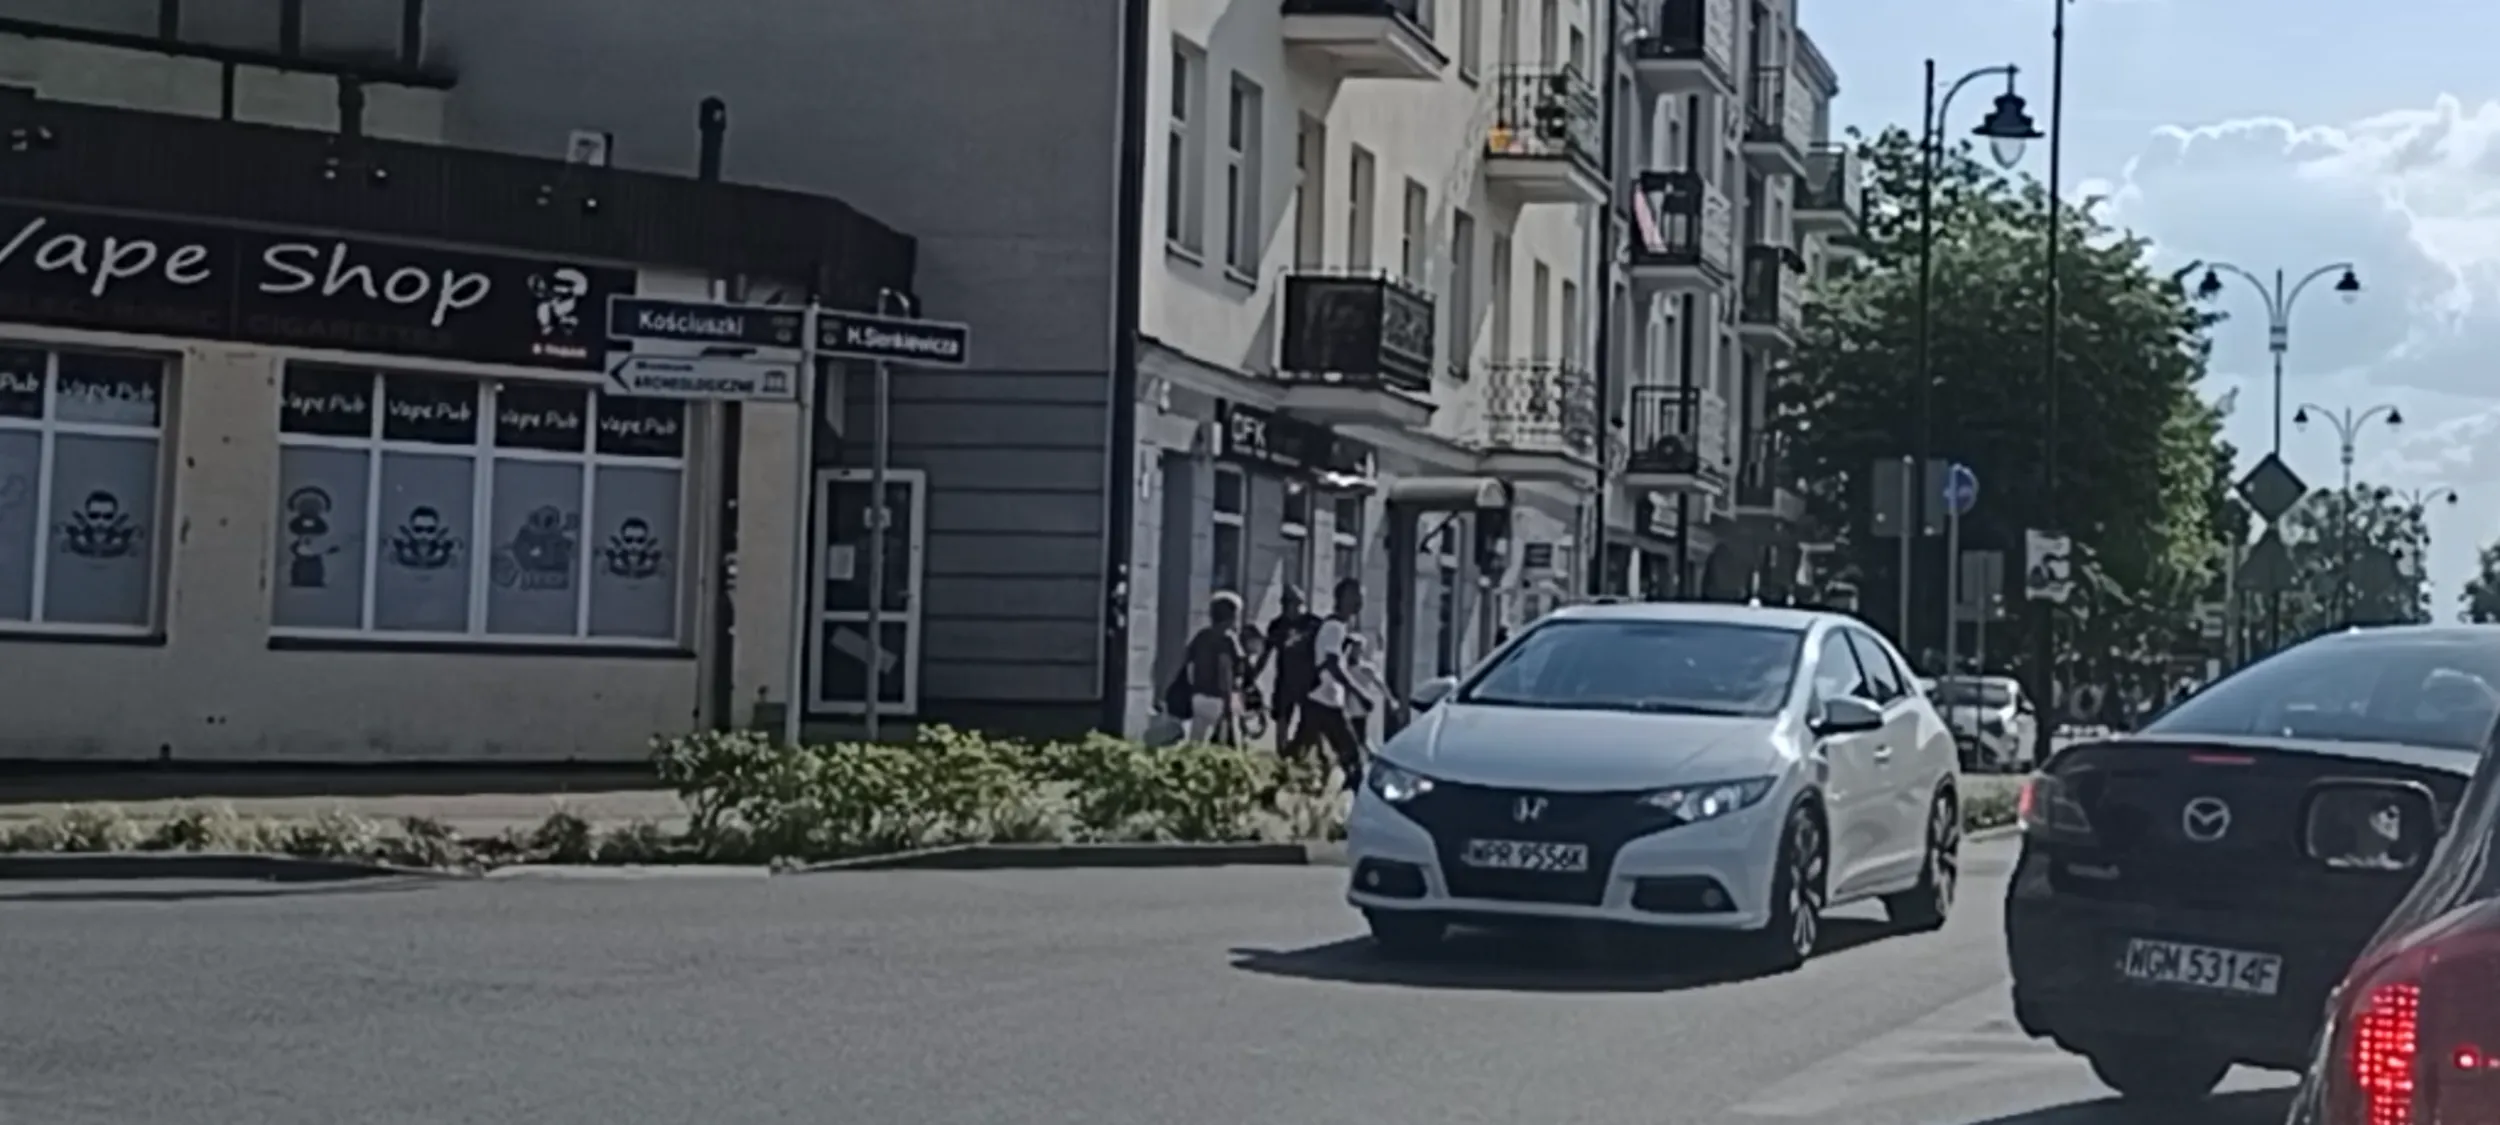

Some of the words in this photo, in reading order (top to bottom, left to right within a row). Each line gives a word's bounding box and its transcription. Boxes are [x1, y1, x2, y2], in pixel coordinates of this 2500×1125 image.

[259, 242, 491, 327] Shop
[638, 309, 745, 337] Kościuszki
[437, 401, 472, 422] Pub
[2130, 940, 2182, 979] WGM
[2187, 947, 2279, 989] 5314F
